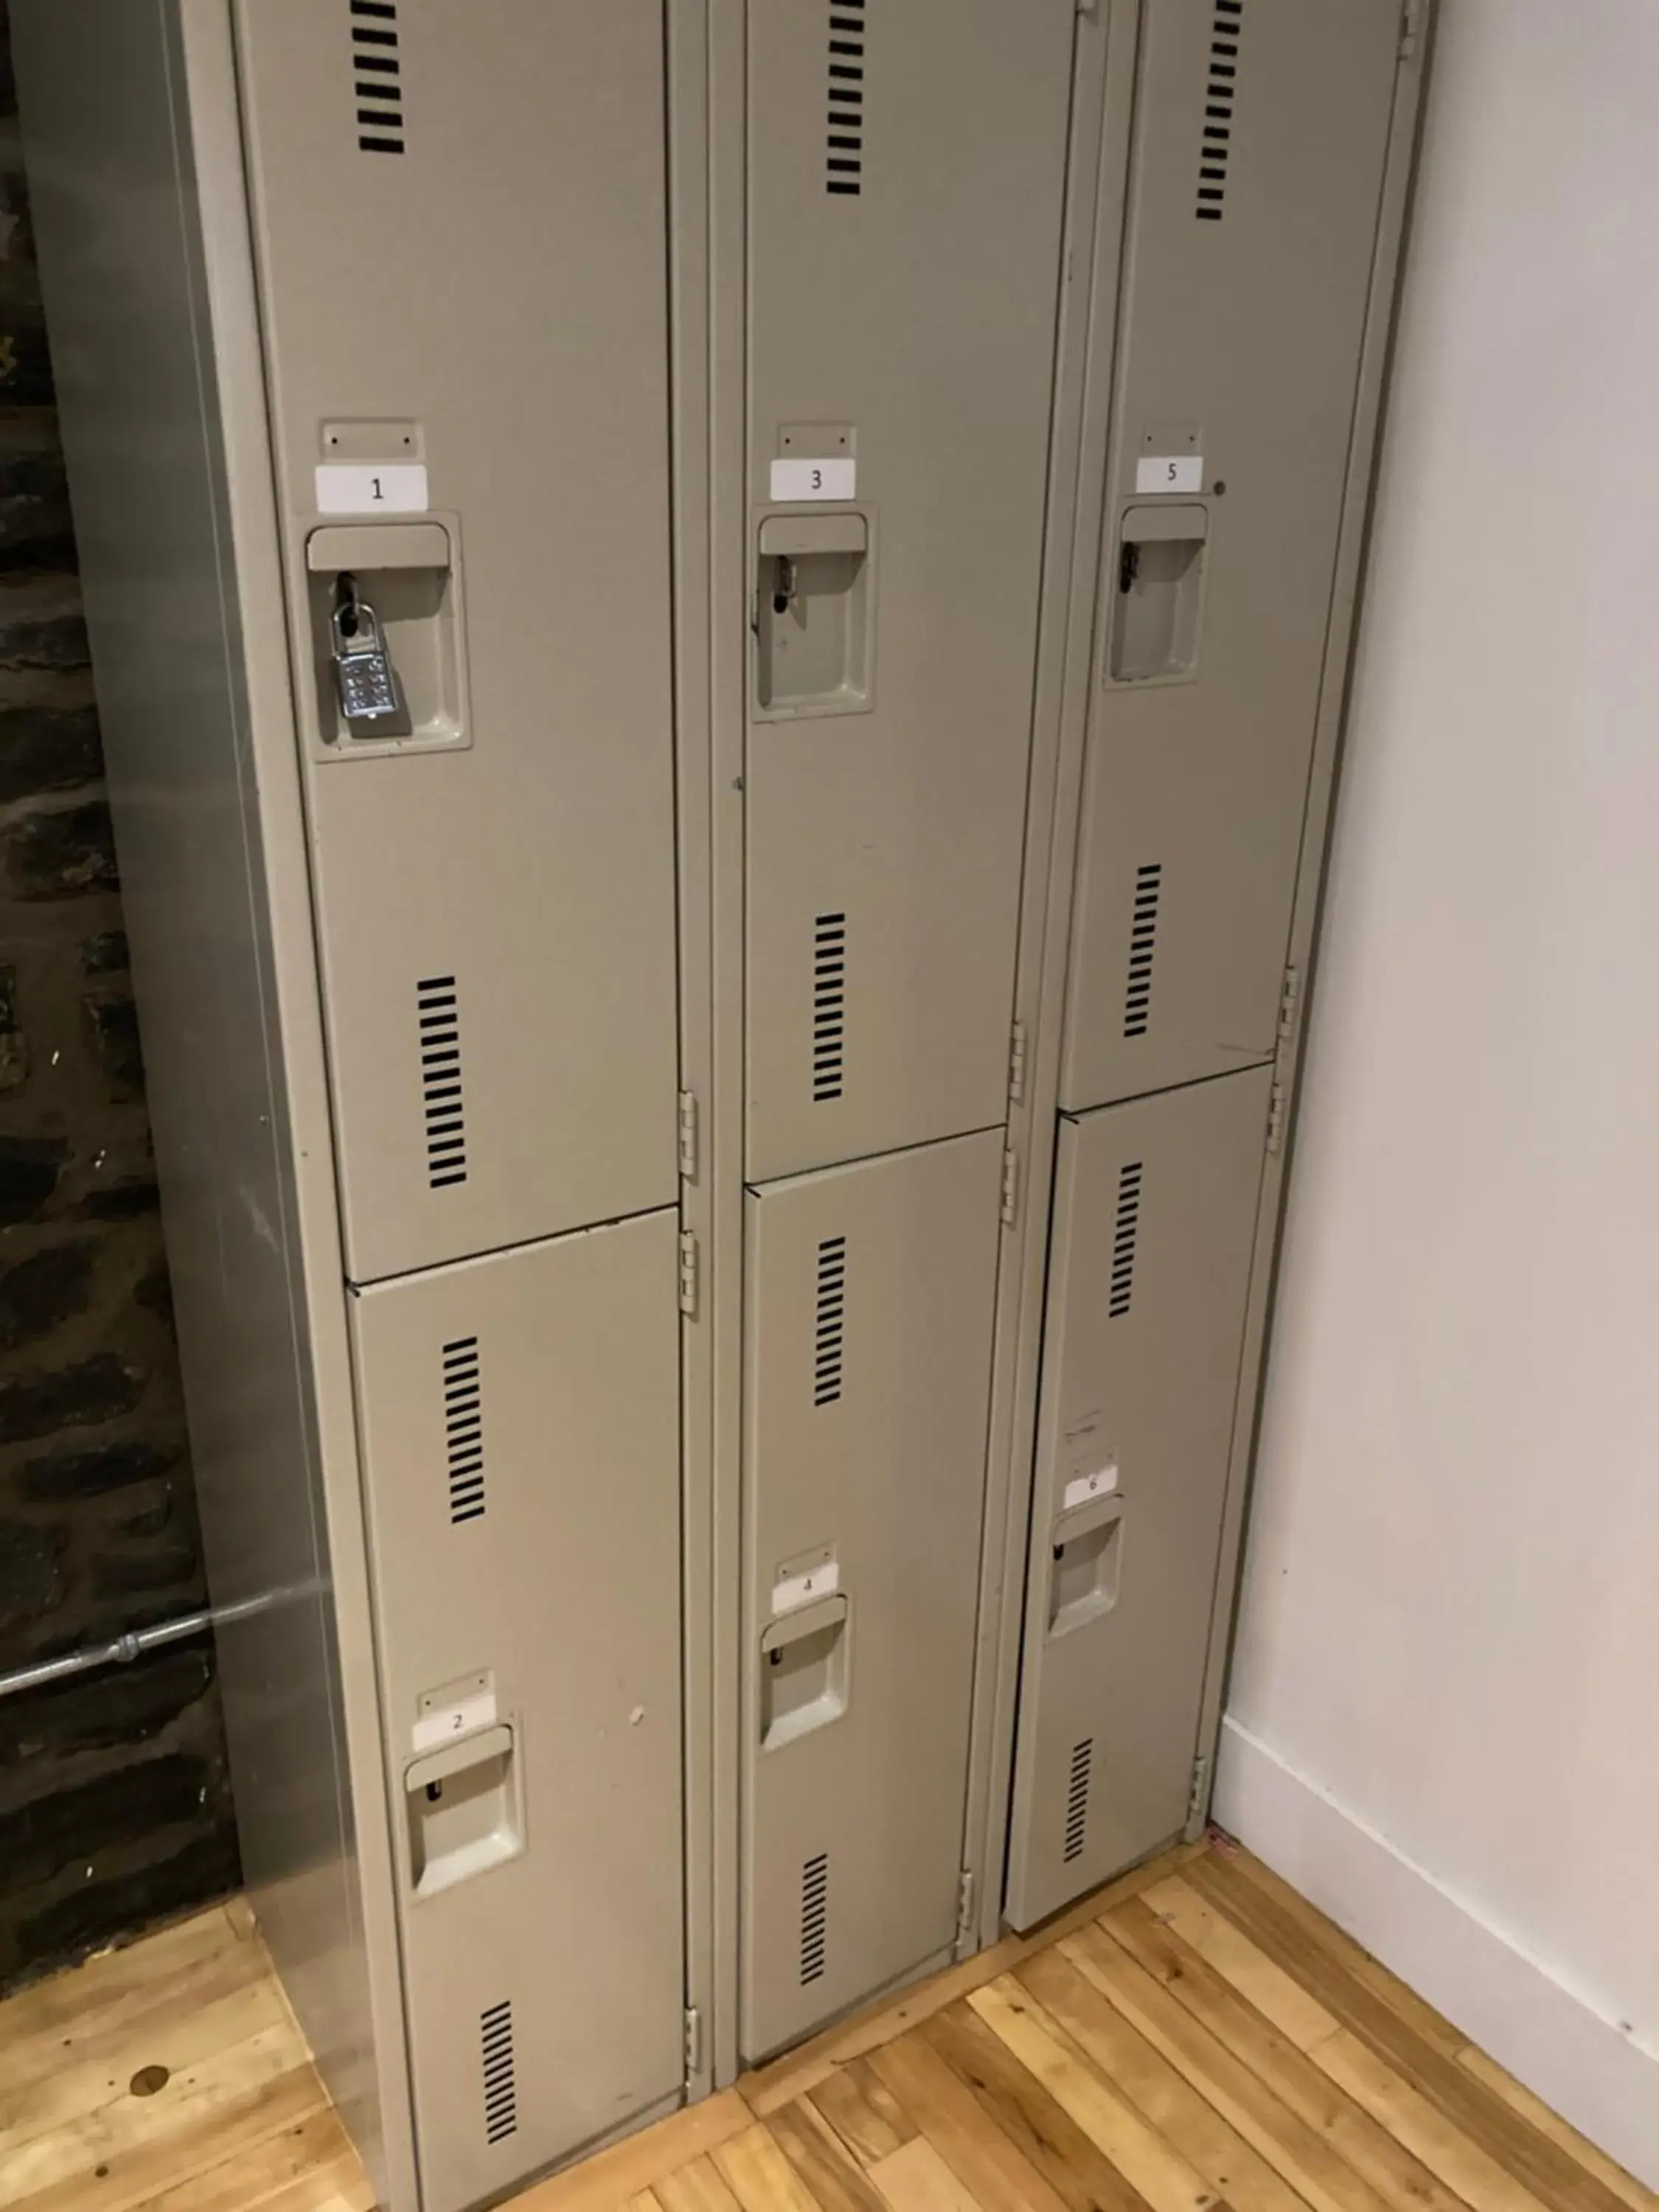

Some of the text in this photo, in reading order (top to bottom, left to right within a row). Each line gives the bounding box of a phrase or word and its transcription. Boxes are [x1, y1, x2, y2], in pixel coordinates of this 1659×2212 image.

[812, 470, 822, 490] 3
[1167, 463, 1177, 481] 5
[372, 478, 383, 500] 1
[1089, 1478, 1098, 1490] 6
[804, 1578, 812, 1590] 4
[453, 1714, 462, 1729] 2
